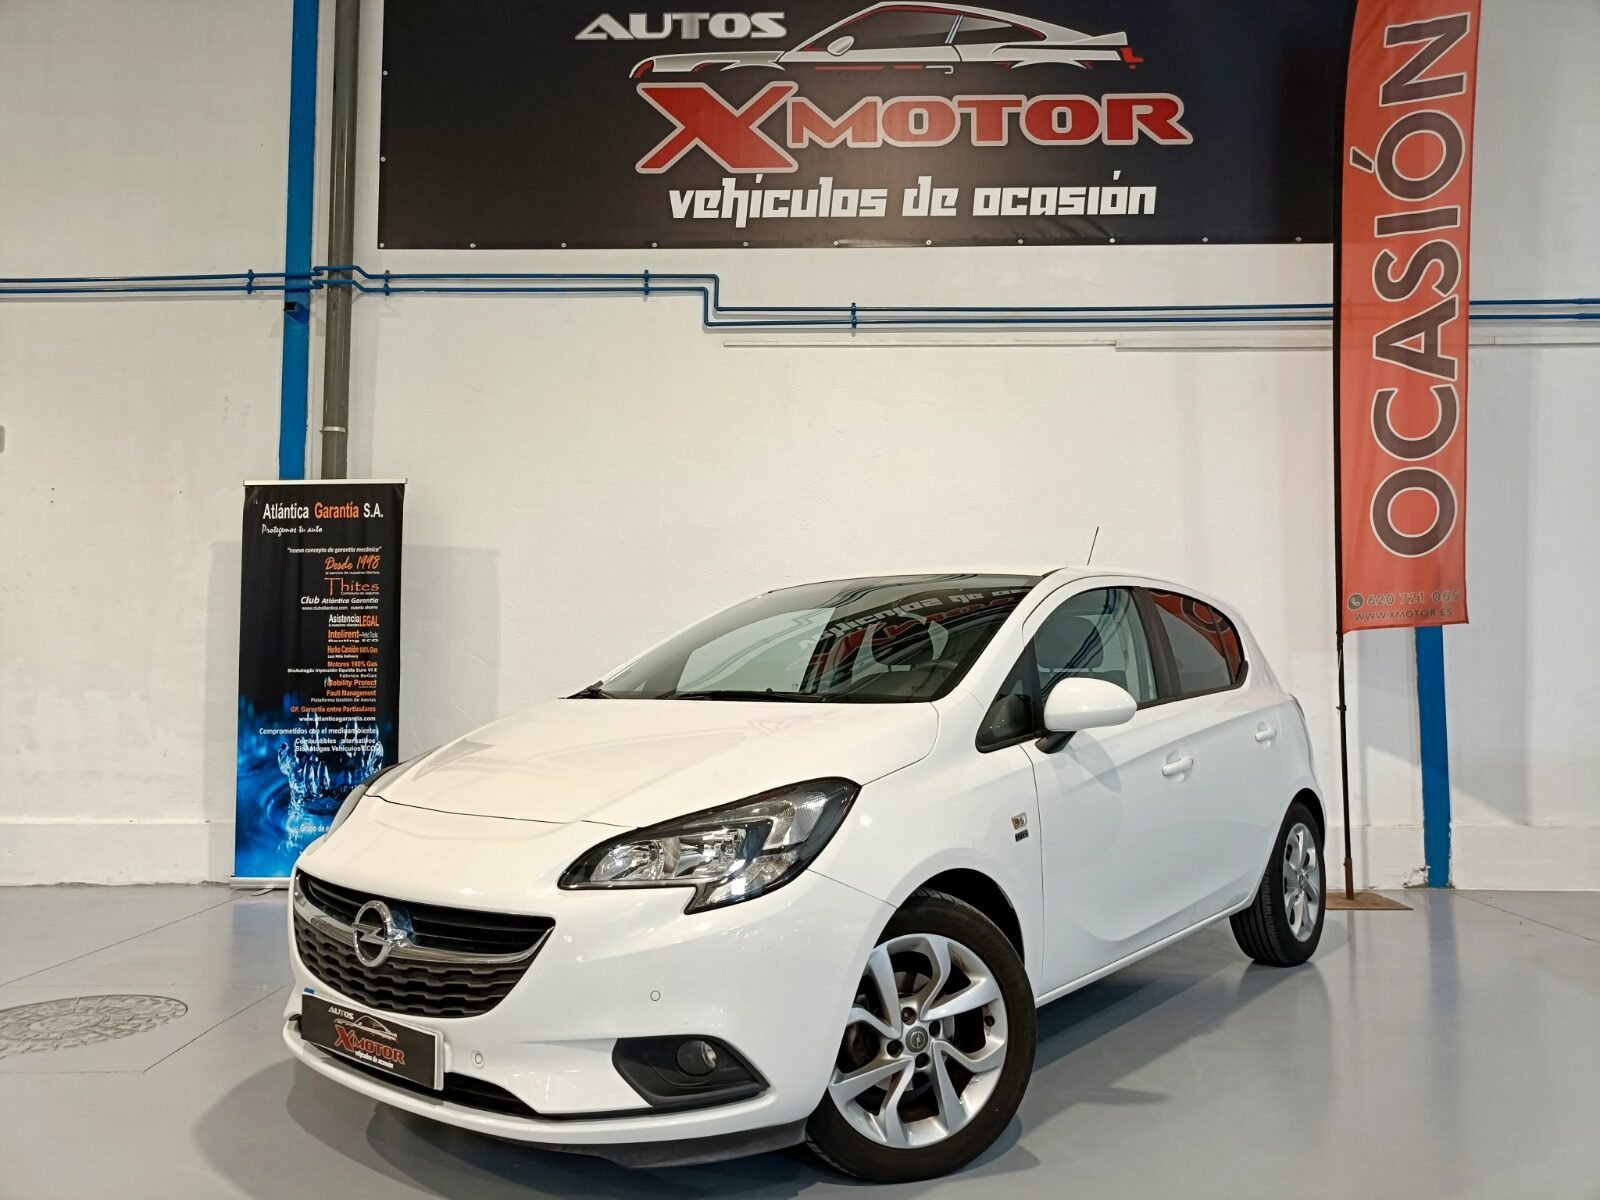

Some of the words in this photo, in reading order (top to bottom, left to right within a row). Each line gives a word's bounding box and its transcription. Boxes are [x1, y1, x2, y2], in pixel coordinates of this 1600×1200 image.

[574, 11, 788, 40] AUTOS
[635, 80, 1194, 174] XMOTOR
[668, 173, 889, 228] vehículos
[903, 176, 957, 217] de
[972, 170, 1158, 216] ocasión
[1350, 12, 1471, 559] OCASIÓN
[262, 502, 310, 520] Atlántica
[314, 501, 360, 520] Garantía
[363, 500, 384, 518] S.A.
[261, 523, 297, 537] Protegemos
[298, 525, 306, 533] tu
[307, 524, 323, 533] auto
[324, 555, 353, 570] Desde
[356, 554, 382, 570] 1998
[324, 577, 380, 596] Thites
[300, 596, 320, 605] Club
[1367, 593, 1395, 607] 620
[1398, 591, 1426, 604] 721
[326, 689, 341, 697] Fault
[317, 823, 326, 832] de
[328, 1005, 354, 1020] AUTOS
